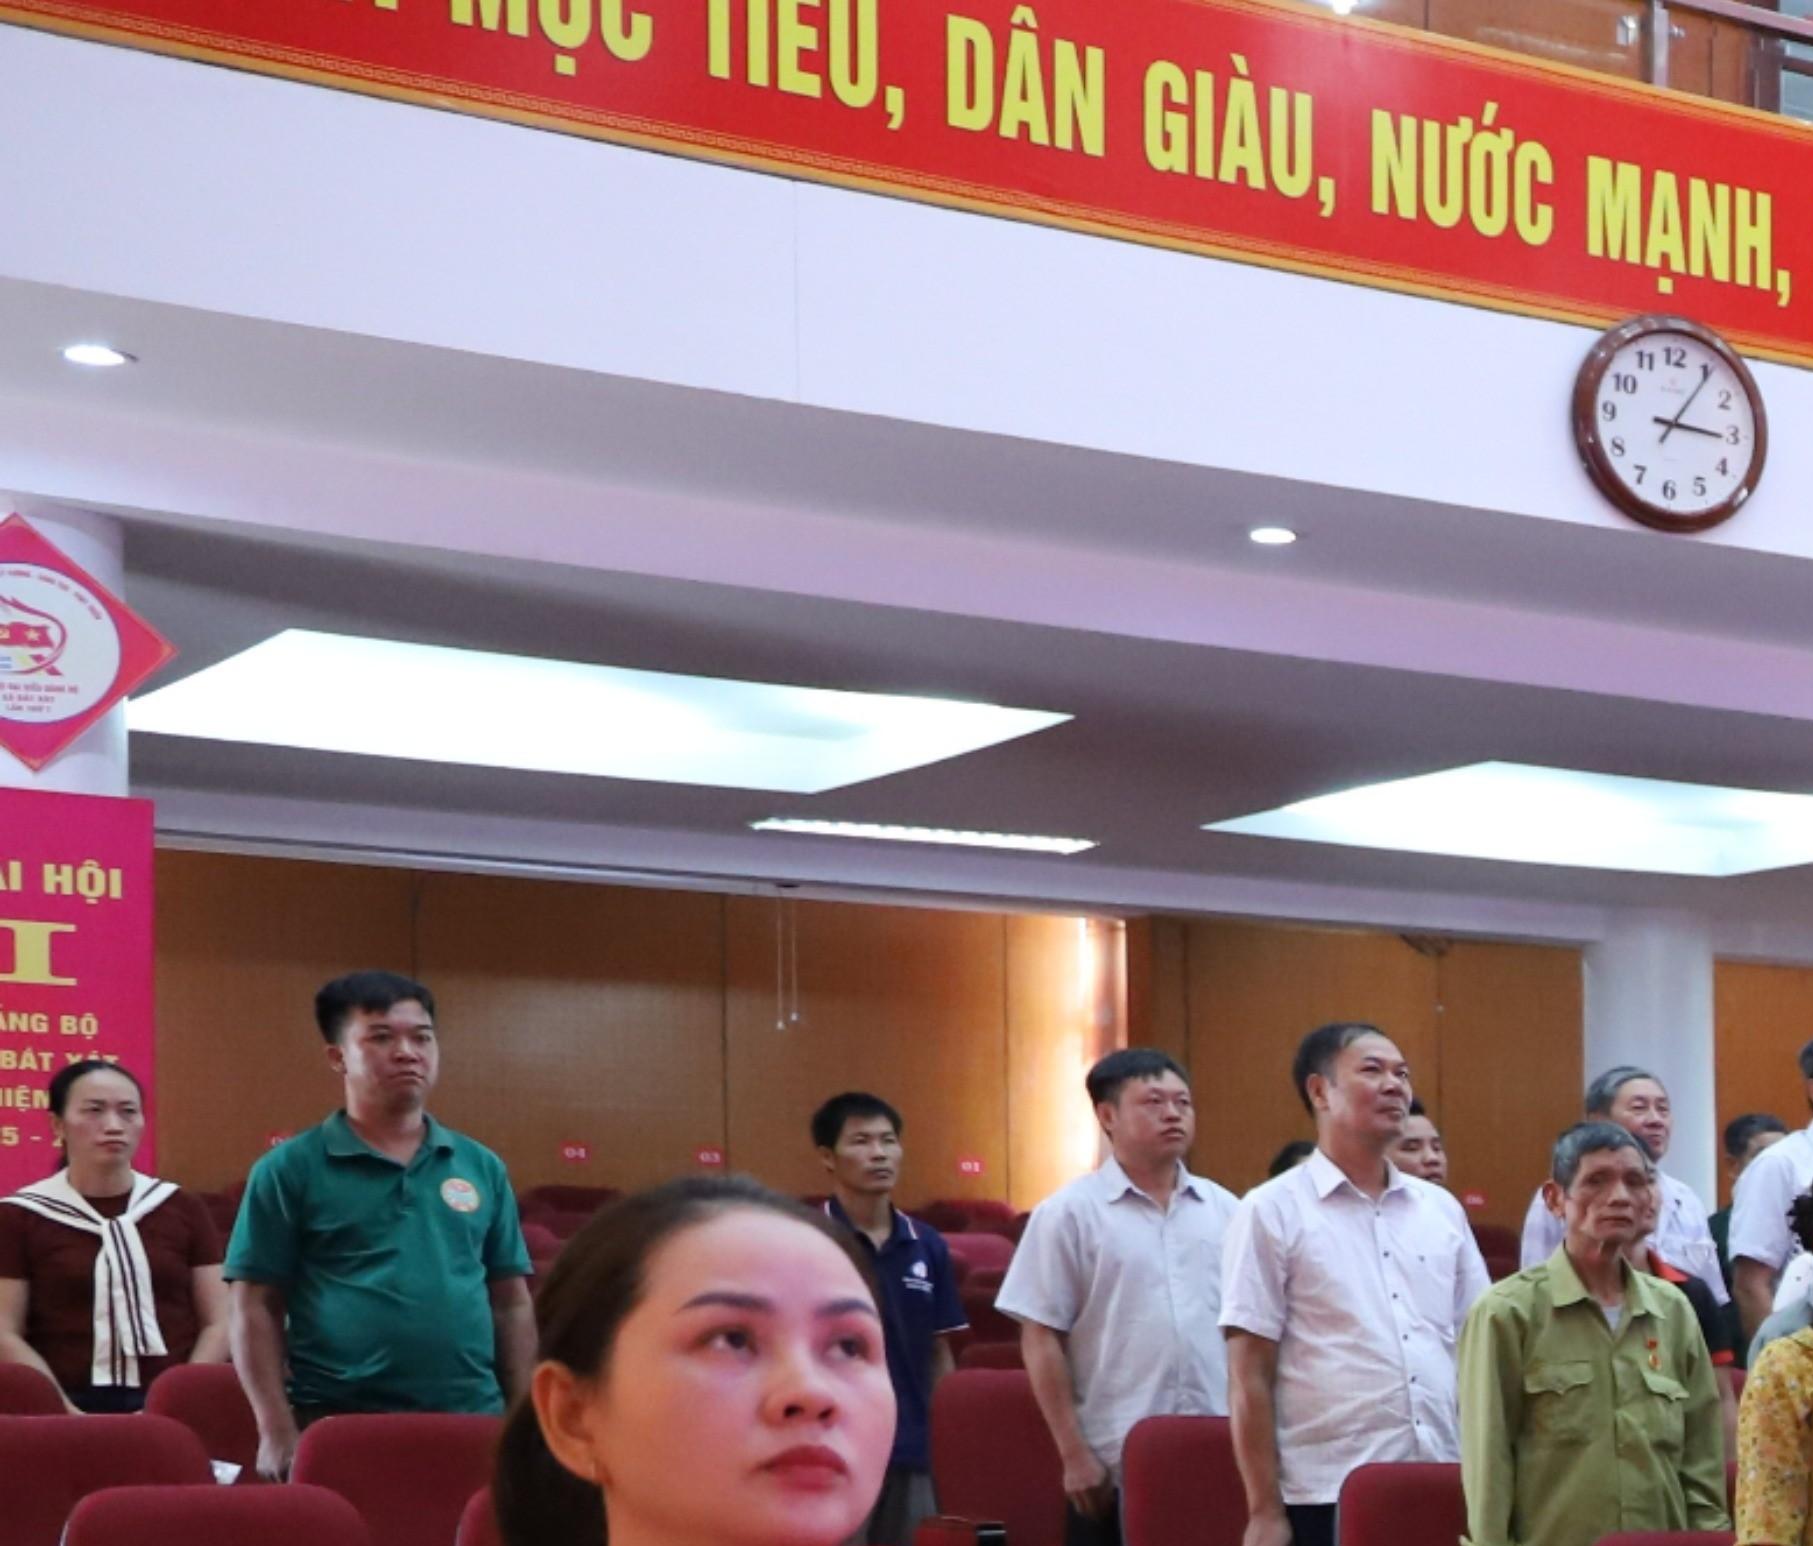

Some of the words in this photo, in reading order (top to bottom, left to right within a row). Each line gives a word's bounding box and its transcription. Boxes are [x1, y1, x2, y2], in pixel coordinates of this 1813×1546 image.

[946, 6, 1104, 157] DÂN
[1143, 54, 1336, 217] GIÀU,
[1370, 101, 1554, 246] NƯỚC
[1586, 155, 1791, 307] MẠNH,
[1636, 350, 1655, 371] 11
[1664, 347, 1687, 369] 12
[1612, 372, 1638, 395] 10
[1718, 390, 1732, 411] 2
[1602, 402, 1617, 421] 9
[1726, 426, 1740, 446] 3
[1611, 437, 1626, 457] 8
[1633, 464, 1648, 485] 7
[1716, 457, 1729, 477] 4
[1663, 480, 1677, 501] 6
[1693, 477, 1707, 497] 5
[42, 858, 123, 904] HỘI
[60, 1012, 99, 1040] BỘ
